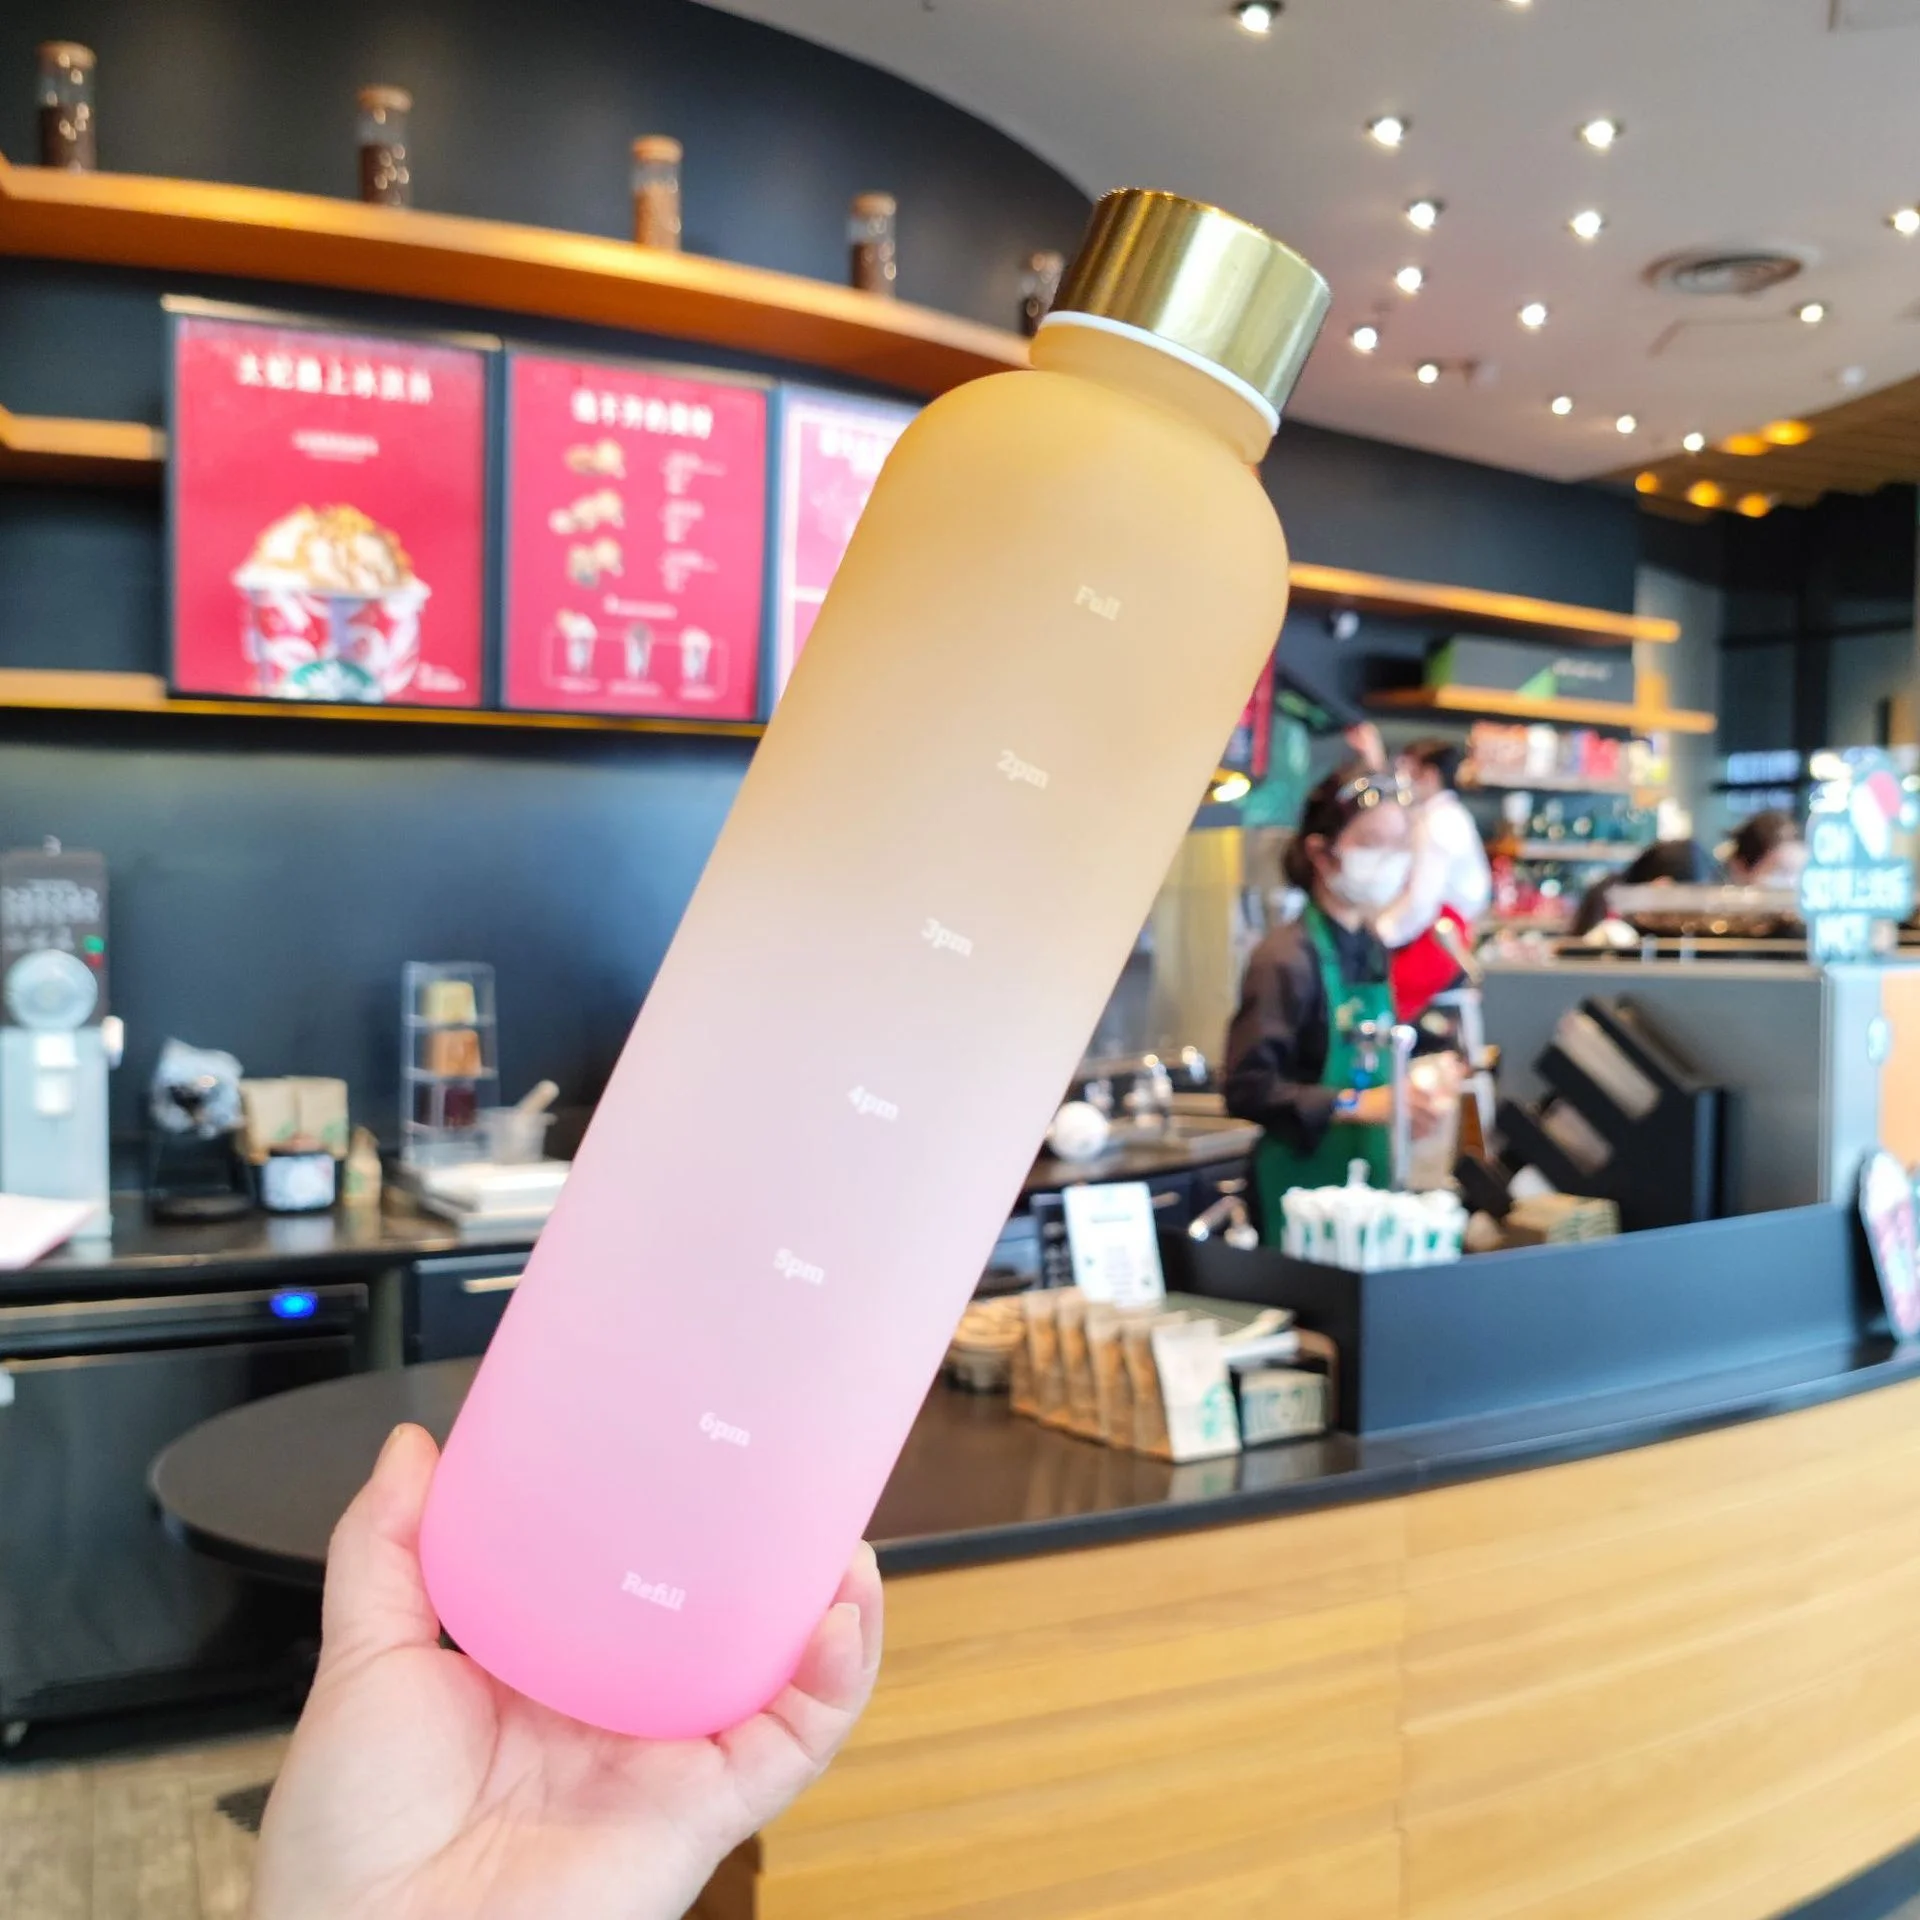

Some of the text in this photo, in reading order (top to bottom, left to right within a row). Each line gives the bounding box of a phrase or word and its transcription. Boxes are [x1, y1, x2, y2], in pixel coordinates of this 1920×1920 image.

[1074, 585, 1121, 620] Full
[997, 749, 1049, 789] 2pm
[921, 917, 973, 957] 3pm
[848, 1085, 899, 1120] 4pm
[773, 1248, 824, 1285] 5pm
[699, 1411, 751, 1447] 6pm
[621, 1570, 686, 1611] Refill
